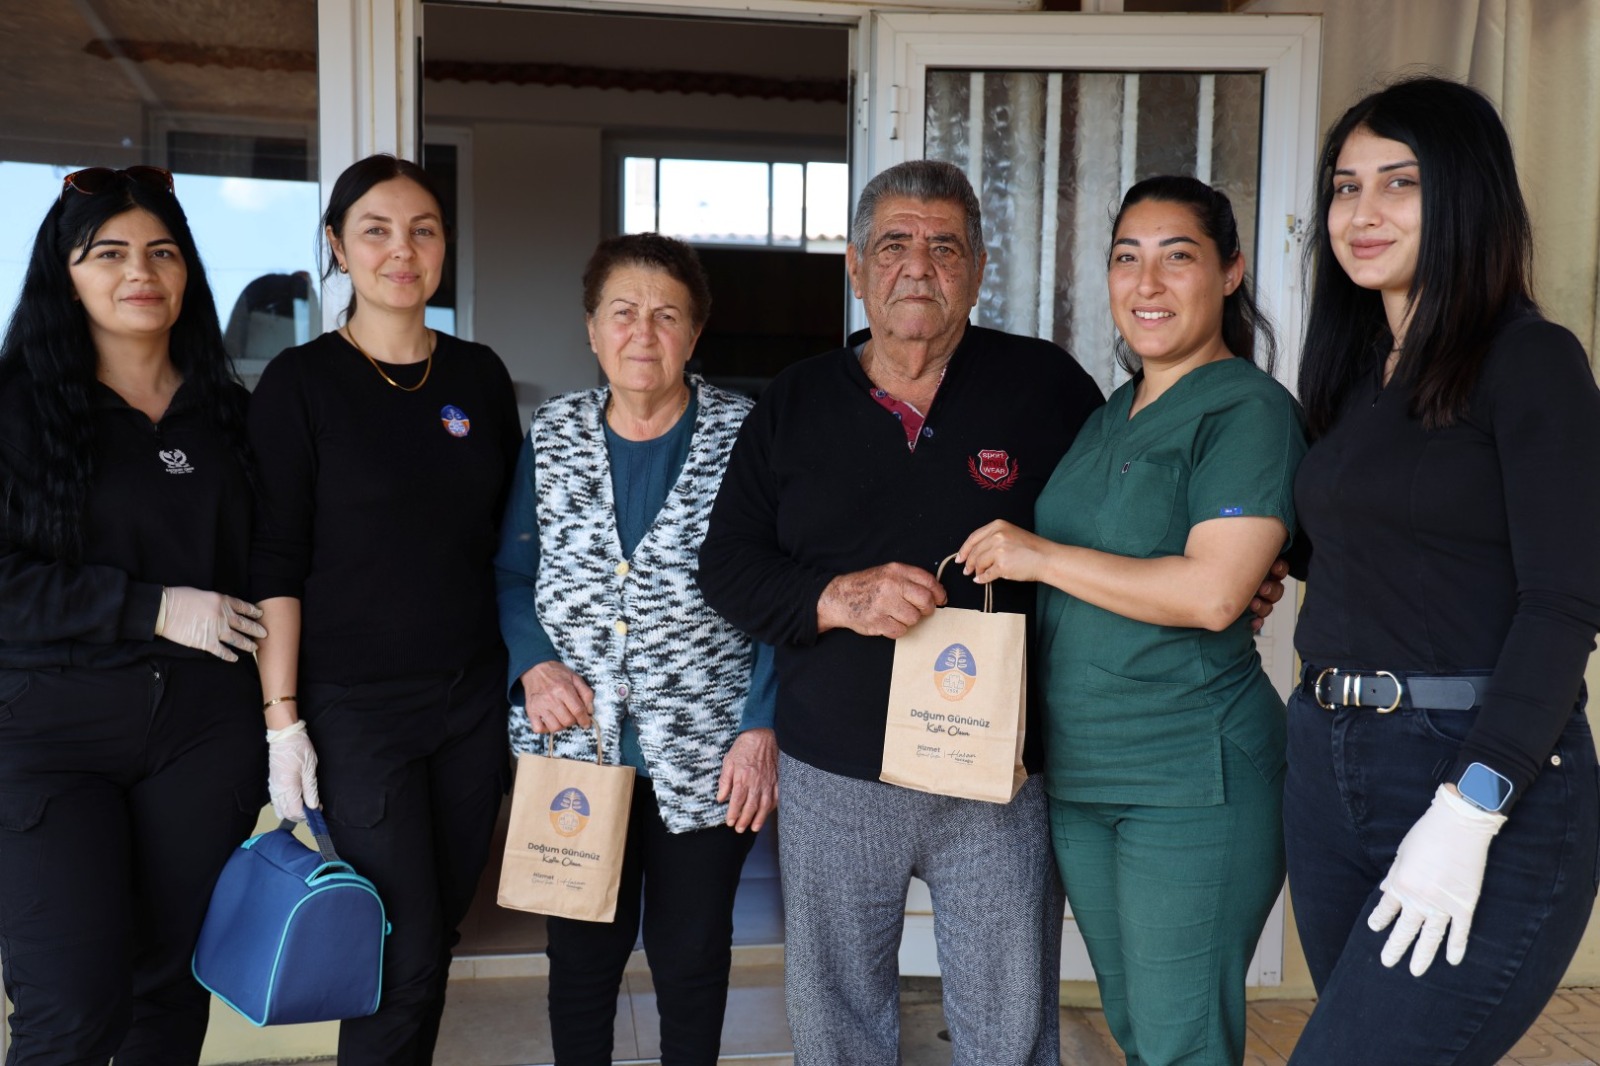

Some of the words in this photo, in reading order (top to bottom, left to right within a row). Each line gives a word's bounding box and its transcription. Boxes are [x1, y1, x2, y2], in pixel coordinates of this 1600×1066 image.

[910, 708, 945, 721] Doğum
[947, 714, 990, 728] Gününüz
[527, 842, 560, 853] Doğum
[561, 848, 600, 861] Gününüz
